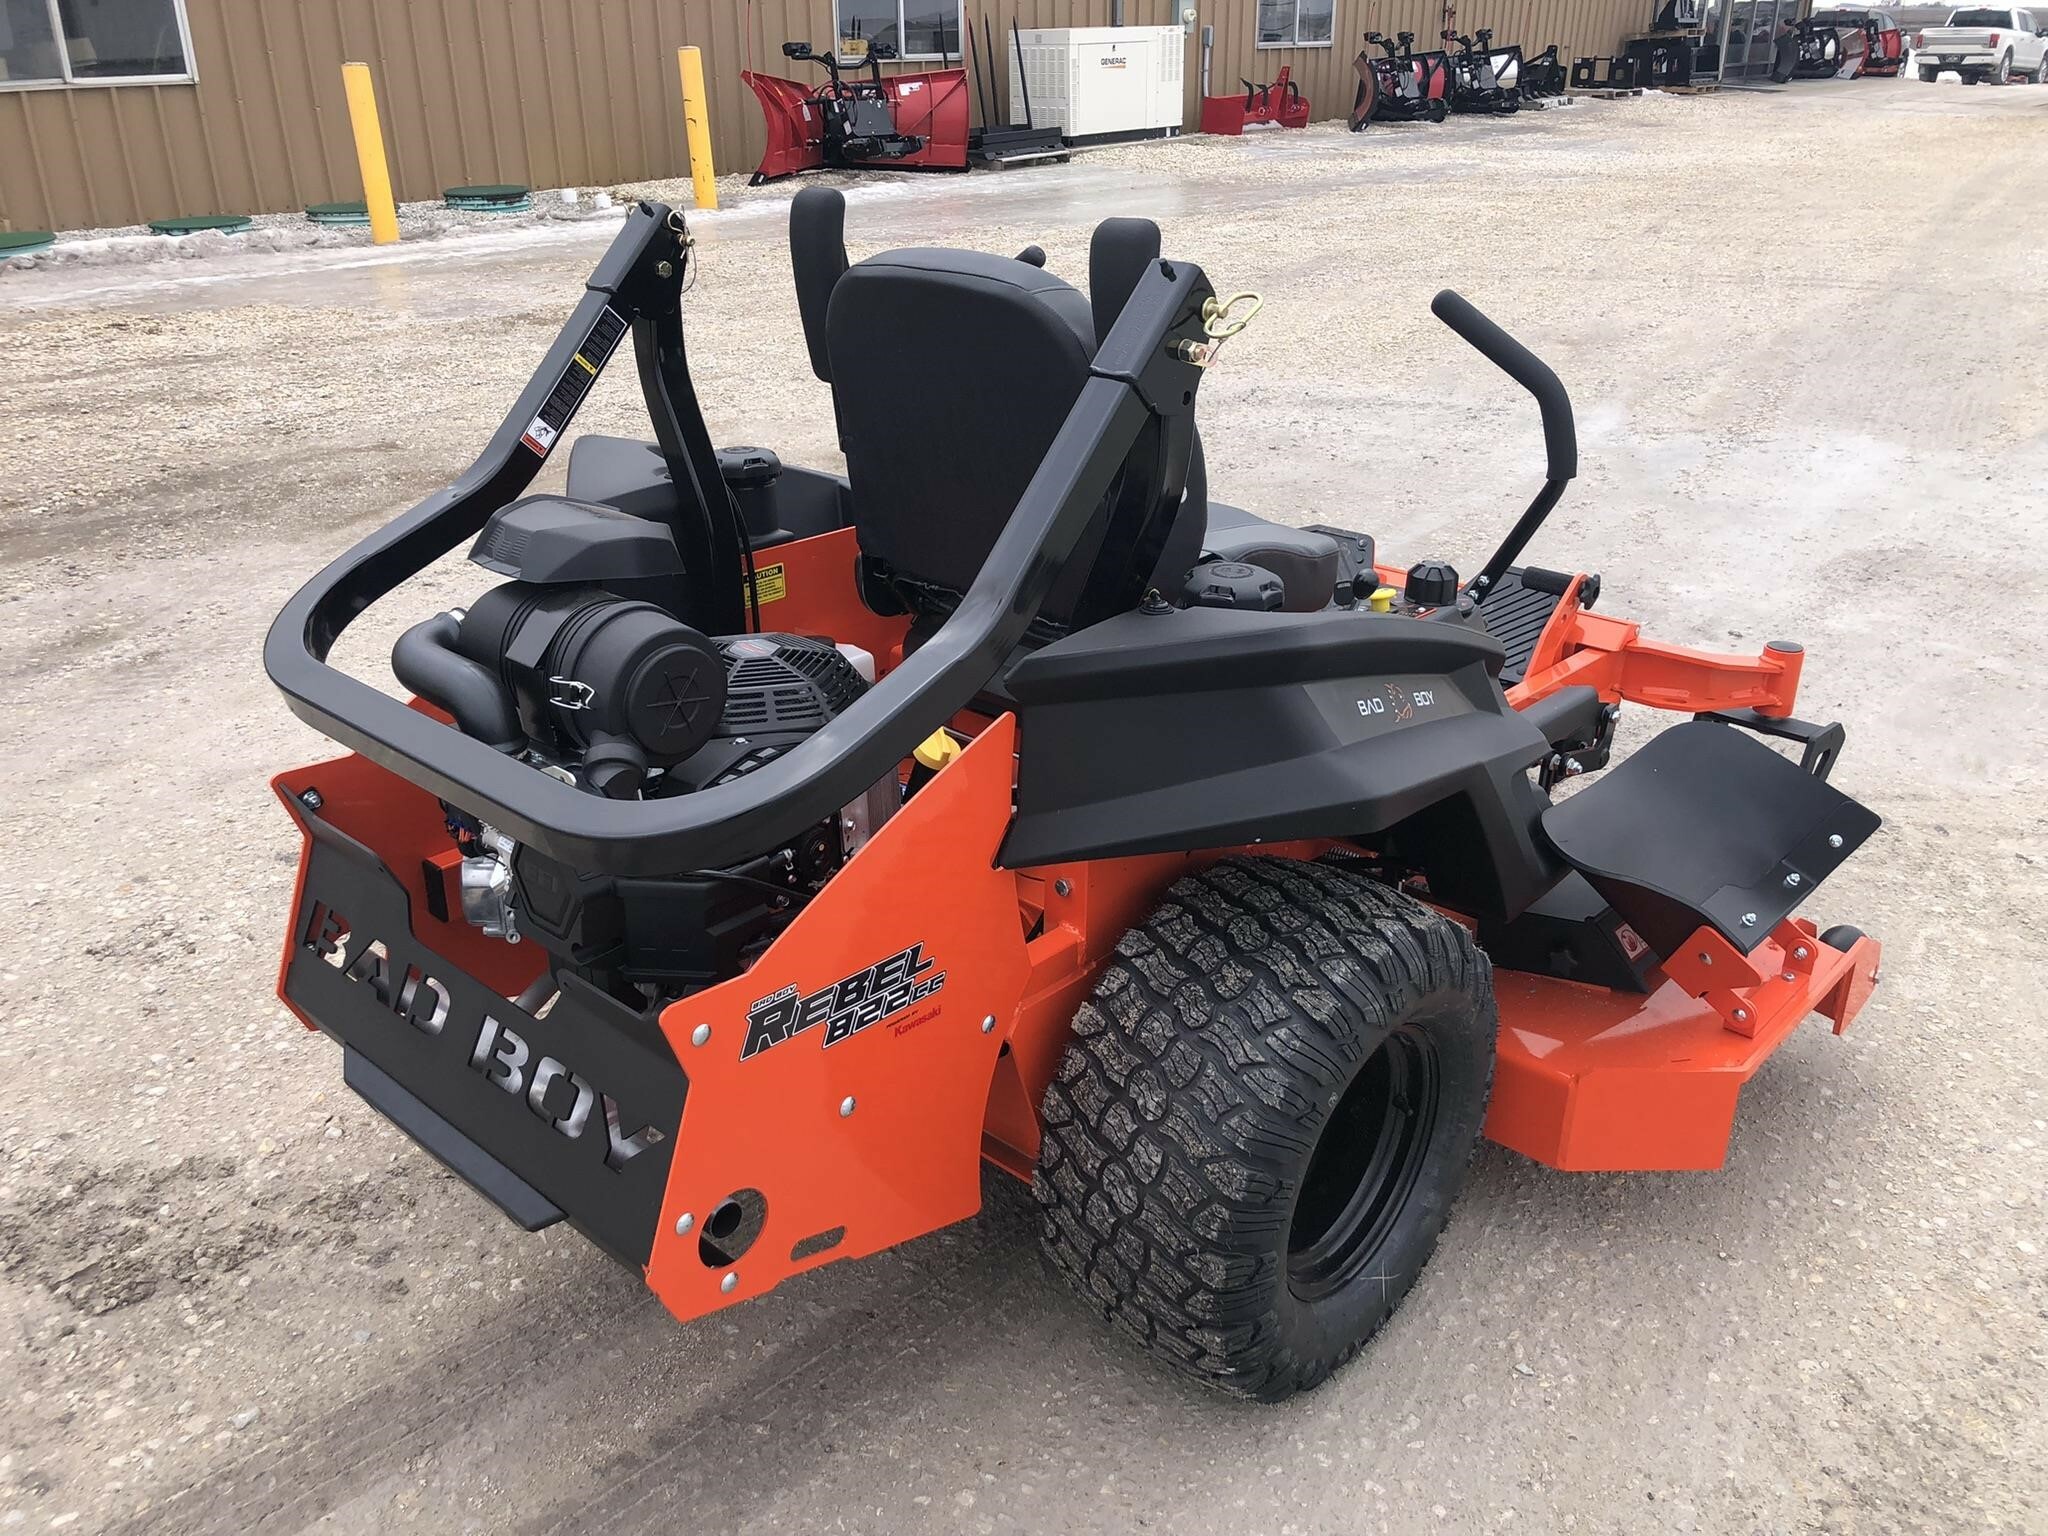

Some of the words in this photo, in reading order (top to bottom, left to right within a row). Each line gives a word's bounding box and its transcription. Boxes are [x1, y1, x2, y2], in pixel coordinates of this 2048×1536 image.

[1100, 57, 1126, 65] GENERAC
[1356, 697, 1385, 716] BAD
[1412, 690, 1435, 707] BOY
[739, 941, 936, 1063] REBEL
[751, 993, 775, 1012] BAD
[774, 983, 798, 1001] BOY
[894, 1004, 942, 1038] Kawasaki
[304, 900, 451, 1035] BAD
[468, 1014, 666, 1174] BOY
